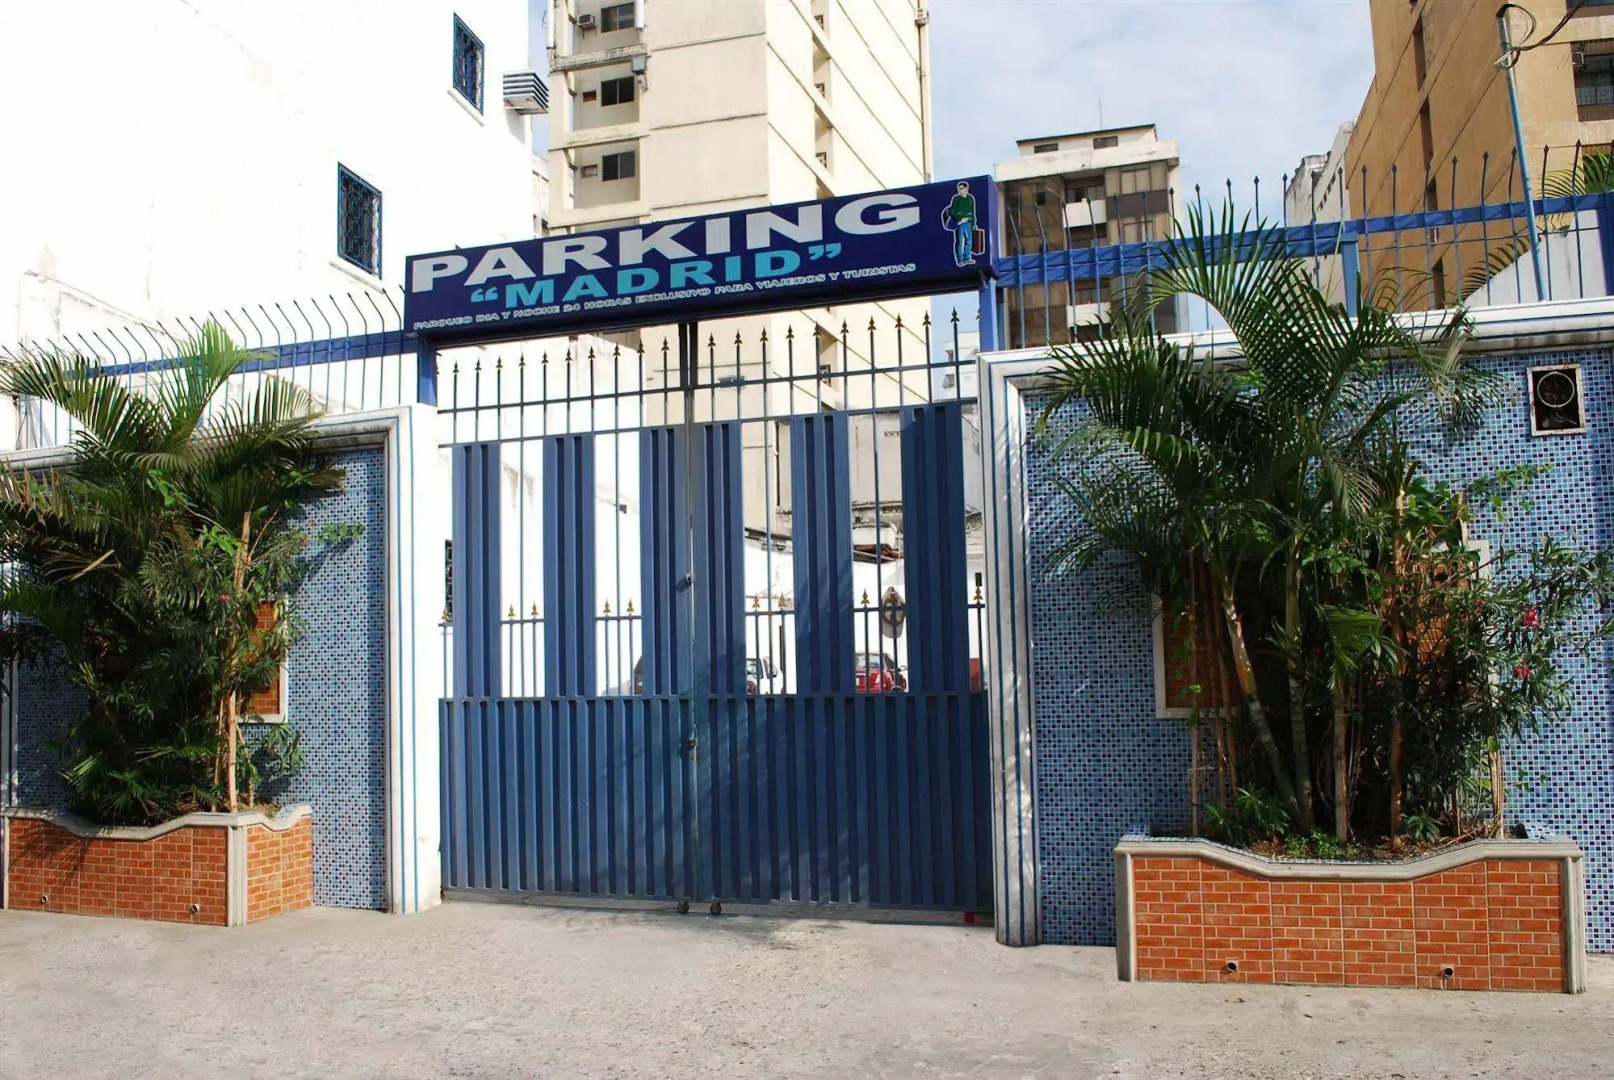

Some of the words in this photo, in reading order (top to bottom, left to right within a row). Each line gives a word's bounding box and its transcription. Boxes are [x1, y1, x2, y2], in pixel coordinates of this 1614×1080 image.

[411, 193, 921, 294] PARKING
[413, 315, 473, 330] PARQUEO
[476, 312, 499, 323] DIA
[501, 310, 511, 320] Y
[513, 305, 560, 318] NOCHE
[563, 303, 581, 313] 24
[584, 296, 632, 310] HORAS
[635, 287, 711, 304] EXCLUSIVO
[714, 282, 753, 295] PARA
[755, 273, 826, 290] VIAJEROS
[829, 271, 840, 281] Y
[842, 263, 916, 280] TURISTAS
